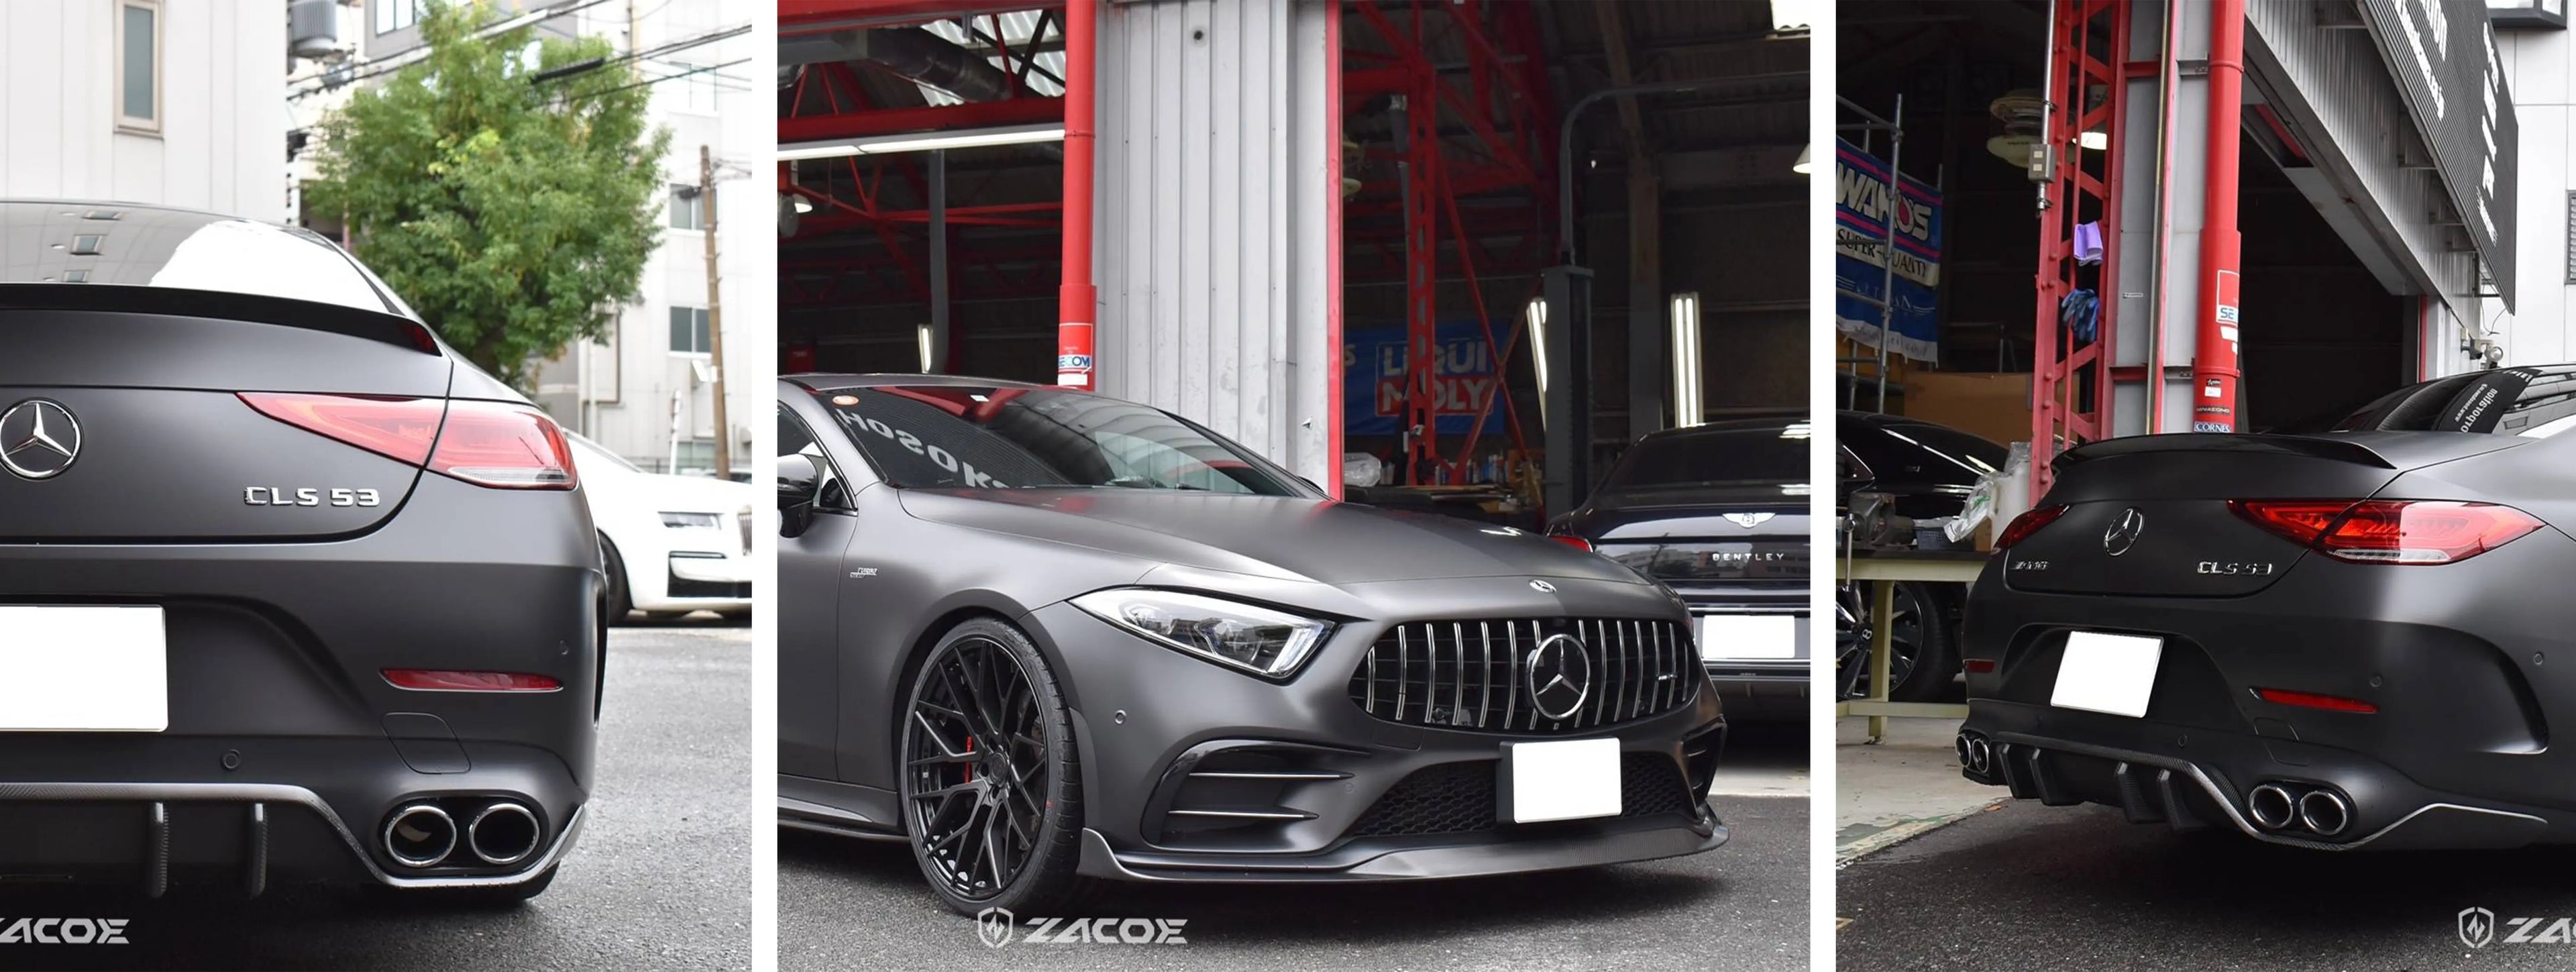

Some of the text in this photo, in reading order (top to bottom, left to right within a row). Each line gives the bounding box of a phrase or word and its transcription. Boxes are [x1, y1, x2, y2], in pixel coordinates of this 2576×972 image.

[1837, 229, 1926, 277] SUPER-UALITY
[2196, 423, 2231, 432] CORNES
[244, 486, 380, 506] CLS 53
[1712, 553, 1784, 561] BENTLEY
[2197, 561, 2272, 576] CLS 53
